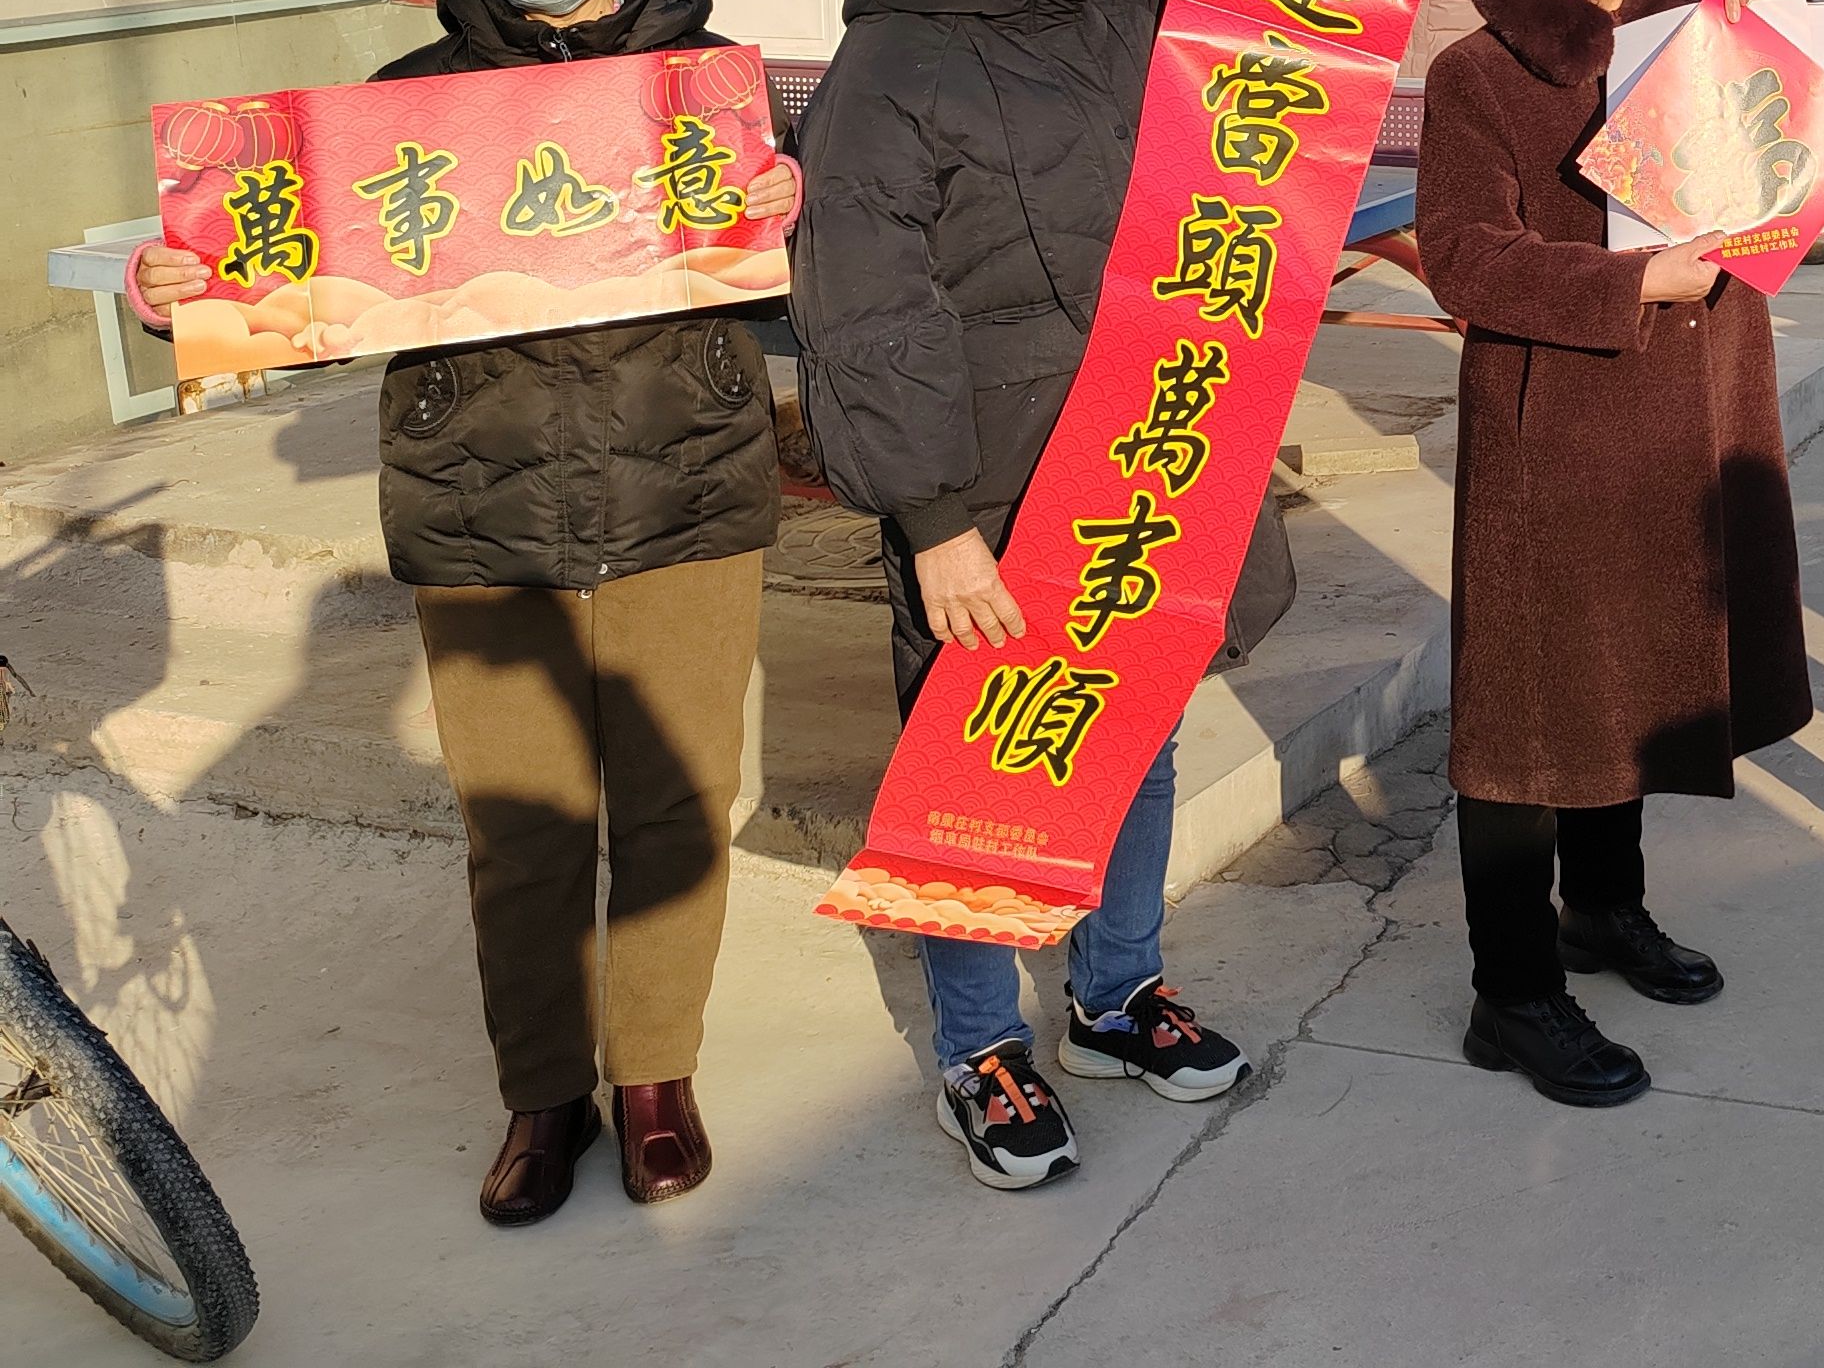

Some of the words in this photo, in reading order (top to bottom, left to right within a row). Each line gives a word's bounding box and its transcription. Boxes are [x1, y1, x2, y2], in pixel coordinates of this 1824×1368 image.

[219, 114, 746, 288] 萬事如意
[1721, 227, 1799, 248] 康庄村支部委员会
